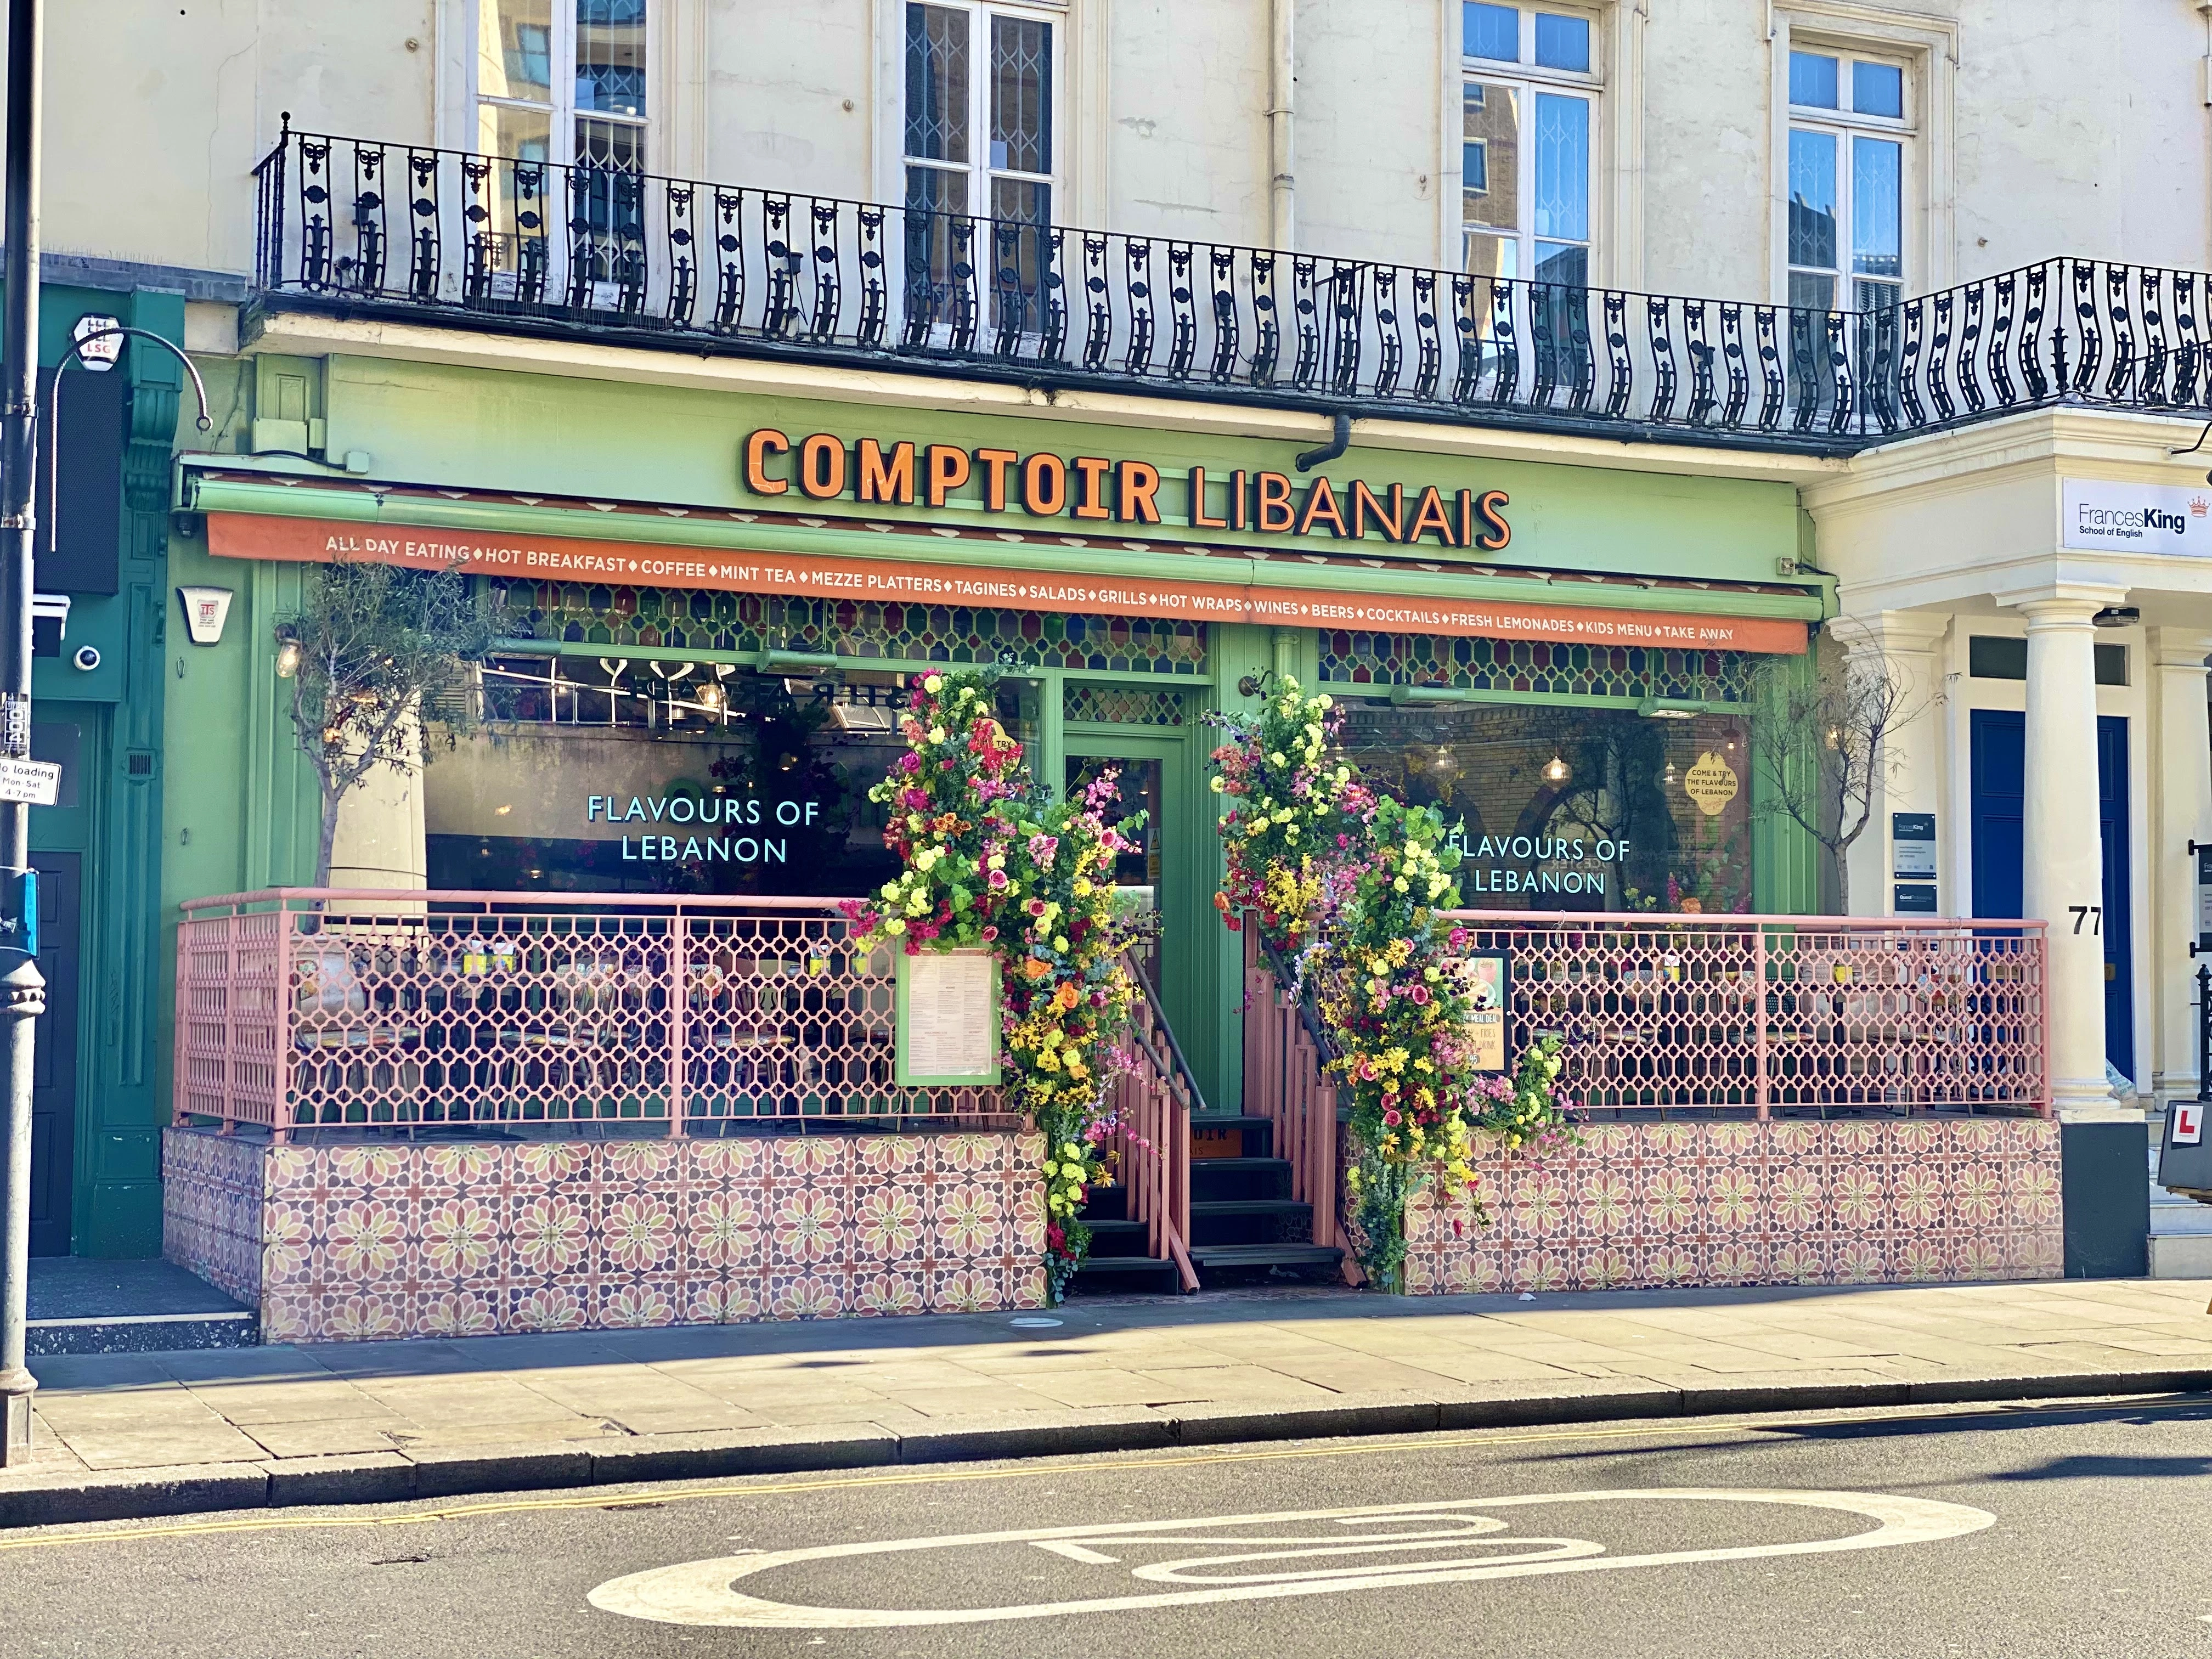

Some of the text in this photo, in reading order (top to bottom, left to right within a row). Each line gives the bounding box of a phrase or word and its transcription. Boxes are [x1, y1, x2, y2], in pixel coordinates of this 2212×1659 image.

[87, 343, 110, 353] LSG
[743, 428, 1511, 551] COMPTOIR LIBANAIS
[2079, 503, 2186, 534] FrancesKing
[2079, 526, 2143, 539] School of English
[326, 536, 1734, 641] ALL DAY EATING HOT BREAKFAST COFFEE MINT TEA MEZZE PLATTERS TAGINES SALADS GRILLS HOT WRAPS WINES BEERS COCKTAILS FRESH LEMONADES KIDS MENU TAKE AWAY
[200, 604, 215, 615] ITS
[14, 764, 54, 780] loading
[587, 794, 820, 827] FLAVOURS OF
[622, 836, 786, 864] LEBANON
[1449, 833, 1630, 862] FLAVOURS OF
[1475, 870, 1605, 895] LEBANON
[2068, 905, 2101, 936] 77
[1471, 1014, 1484, 1023] MEAL
[1486, 1014, 1497, 1023] DEAL
[1481, 1029, 1496, 1038] FRIES
[2179, 1110, 2195, 1134] L
[1026, 1514, 1607, 1584] 20
